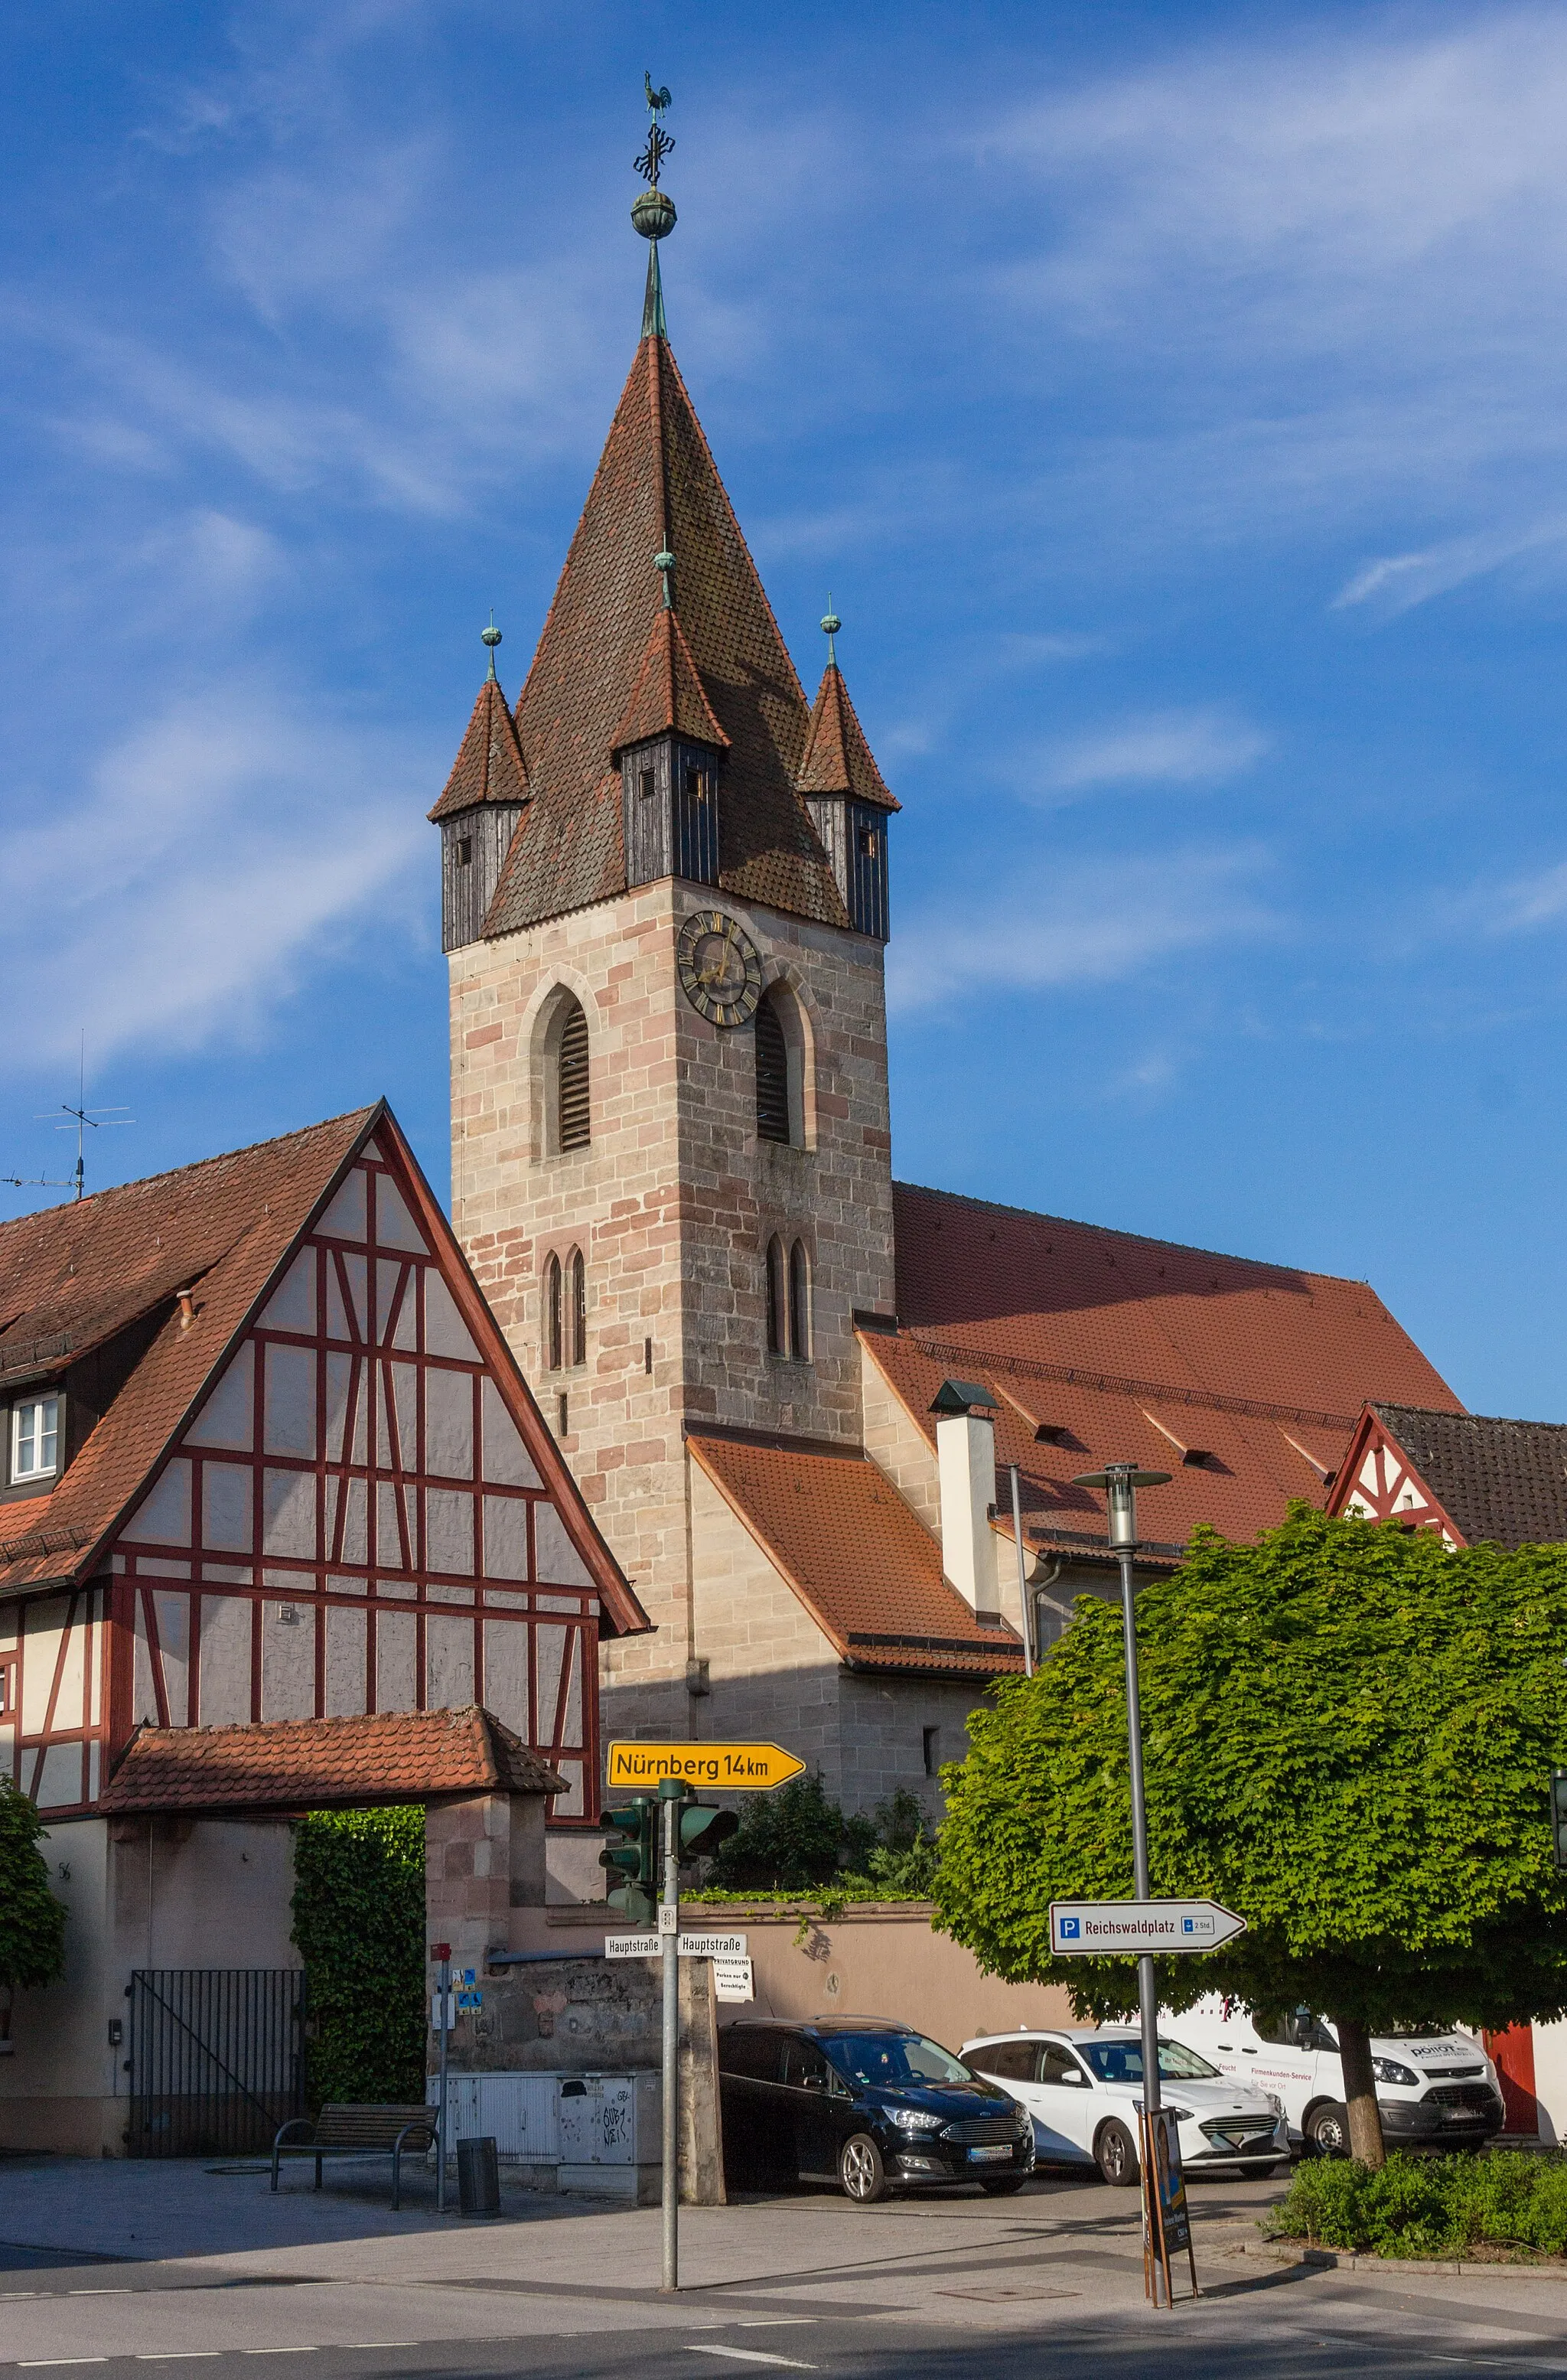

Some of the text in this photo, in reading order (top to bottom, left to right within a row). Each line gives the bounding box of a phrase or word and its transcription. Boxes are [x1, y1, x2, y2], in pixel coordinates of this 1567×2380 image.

[683, 925, 698, 946] X
[747, 971, 761, 986] III
[732, 1003, 744, 1024] V
[616, 1753, 768, 1780] Nürnberg 14 km
[1064, 1919, 1174, 1937] P Reichswaldplatz
[609, 1938, 659, 1955] Hauptstraße
[683, 1937, 741, 1953] Hauptstraße
[1219, 2063, 1236, 2072] Feucht
[1251, 2068, 1311, 2081] Firmenkunden-Service
